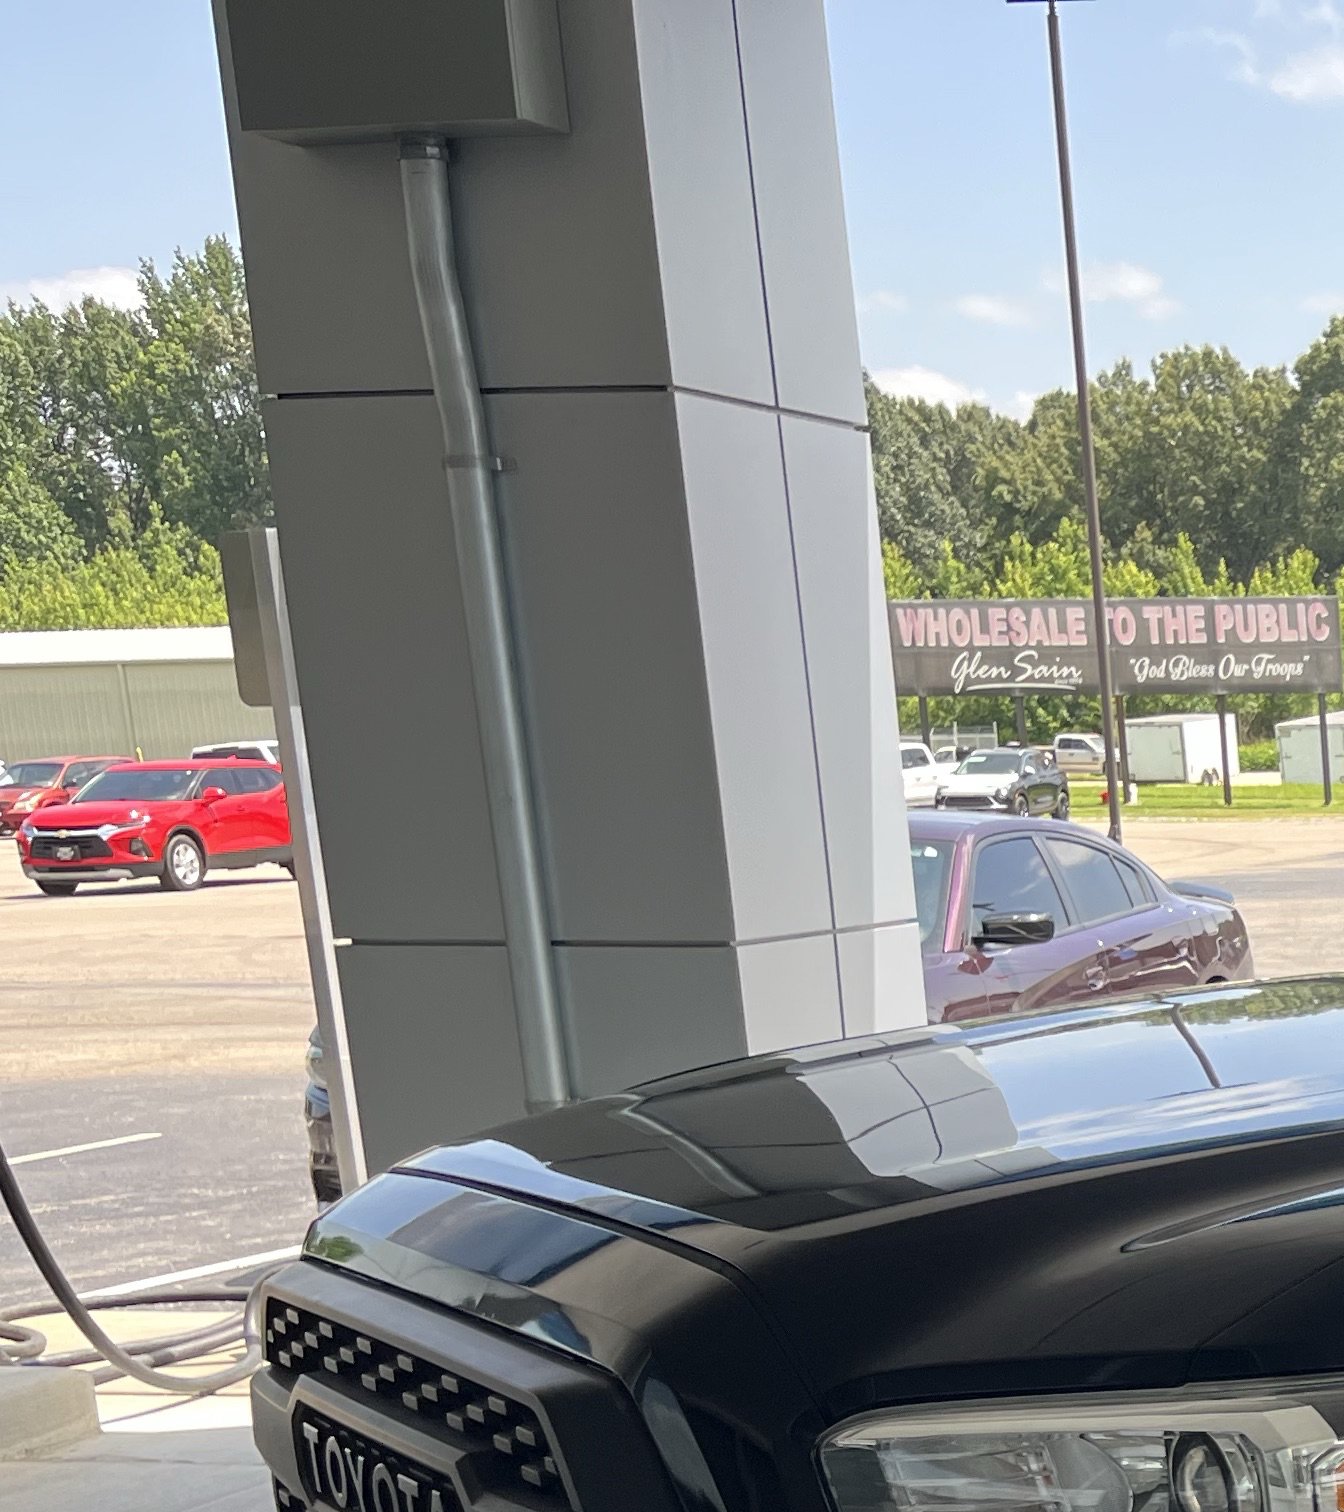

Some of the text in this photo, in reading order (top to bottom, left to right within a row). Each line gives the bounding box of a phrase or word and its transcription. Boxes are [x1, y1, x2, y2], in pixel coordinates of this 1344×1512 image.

[895, 606, 1088, 648] WHOLESALE
[1142, 605, 1207, 645] THE
[1215, 602, 1330, 644] PUBLIC
[951, 650, 1082, 694] Glen Sain
[1169, 655, 1214, 681] Bless
[1219, 655, 1250, 680] Our
